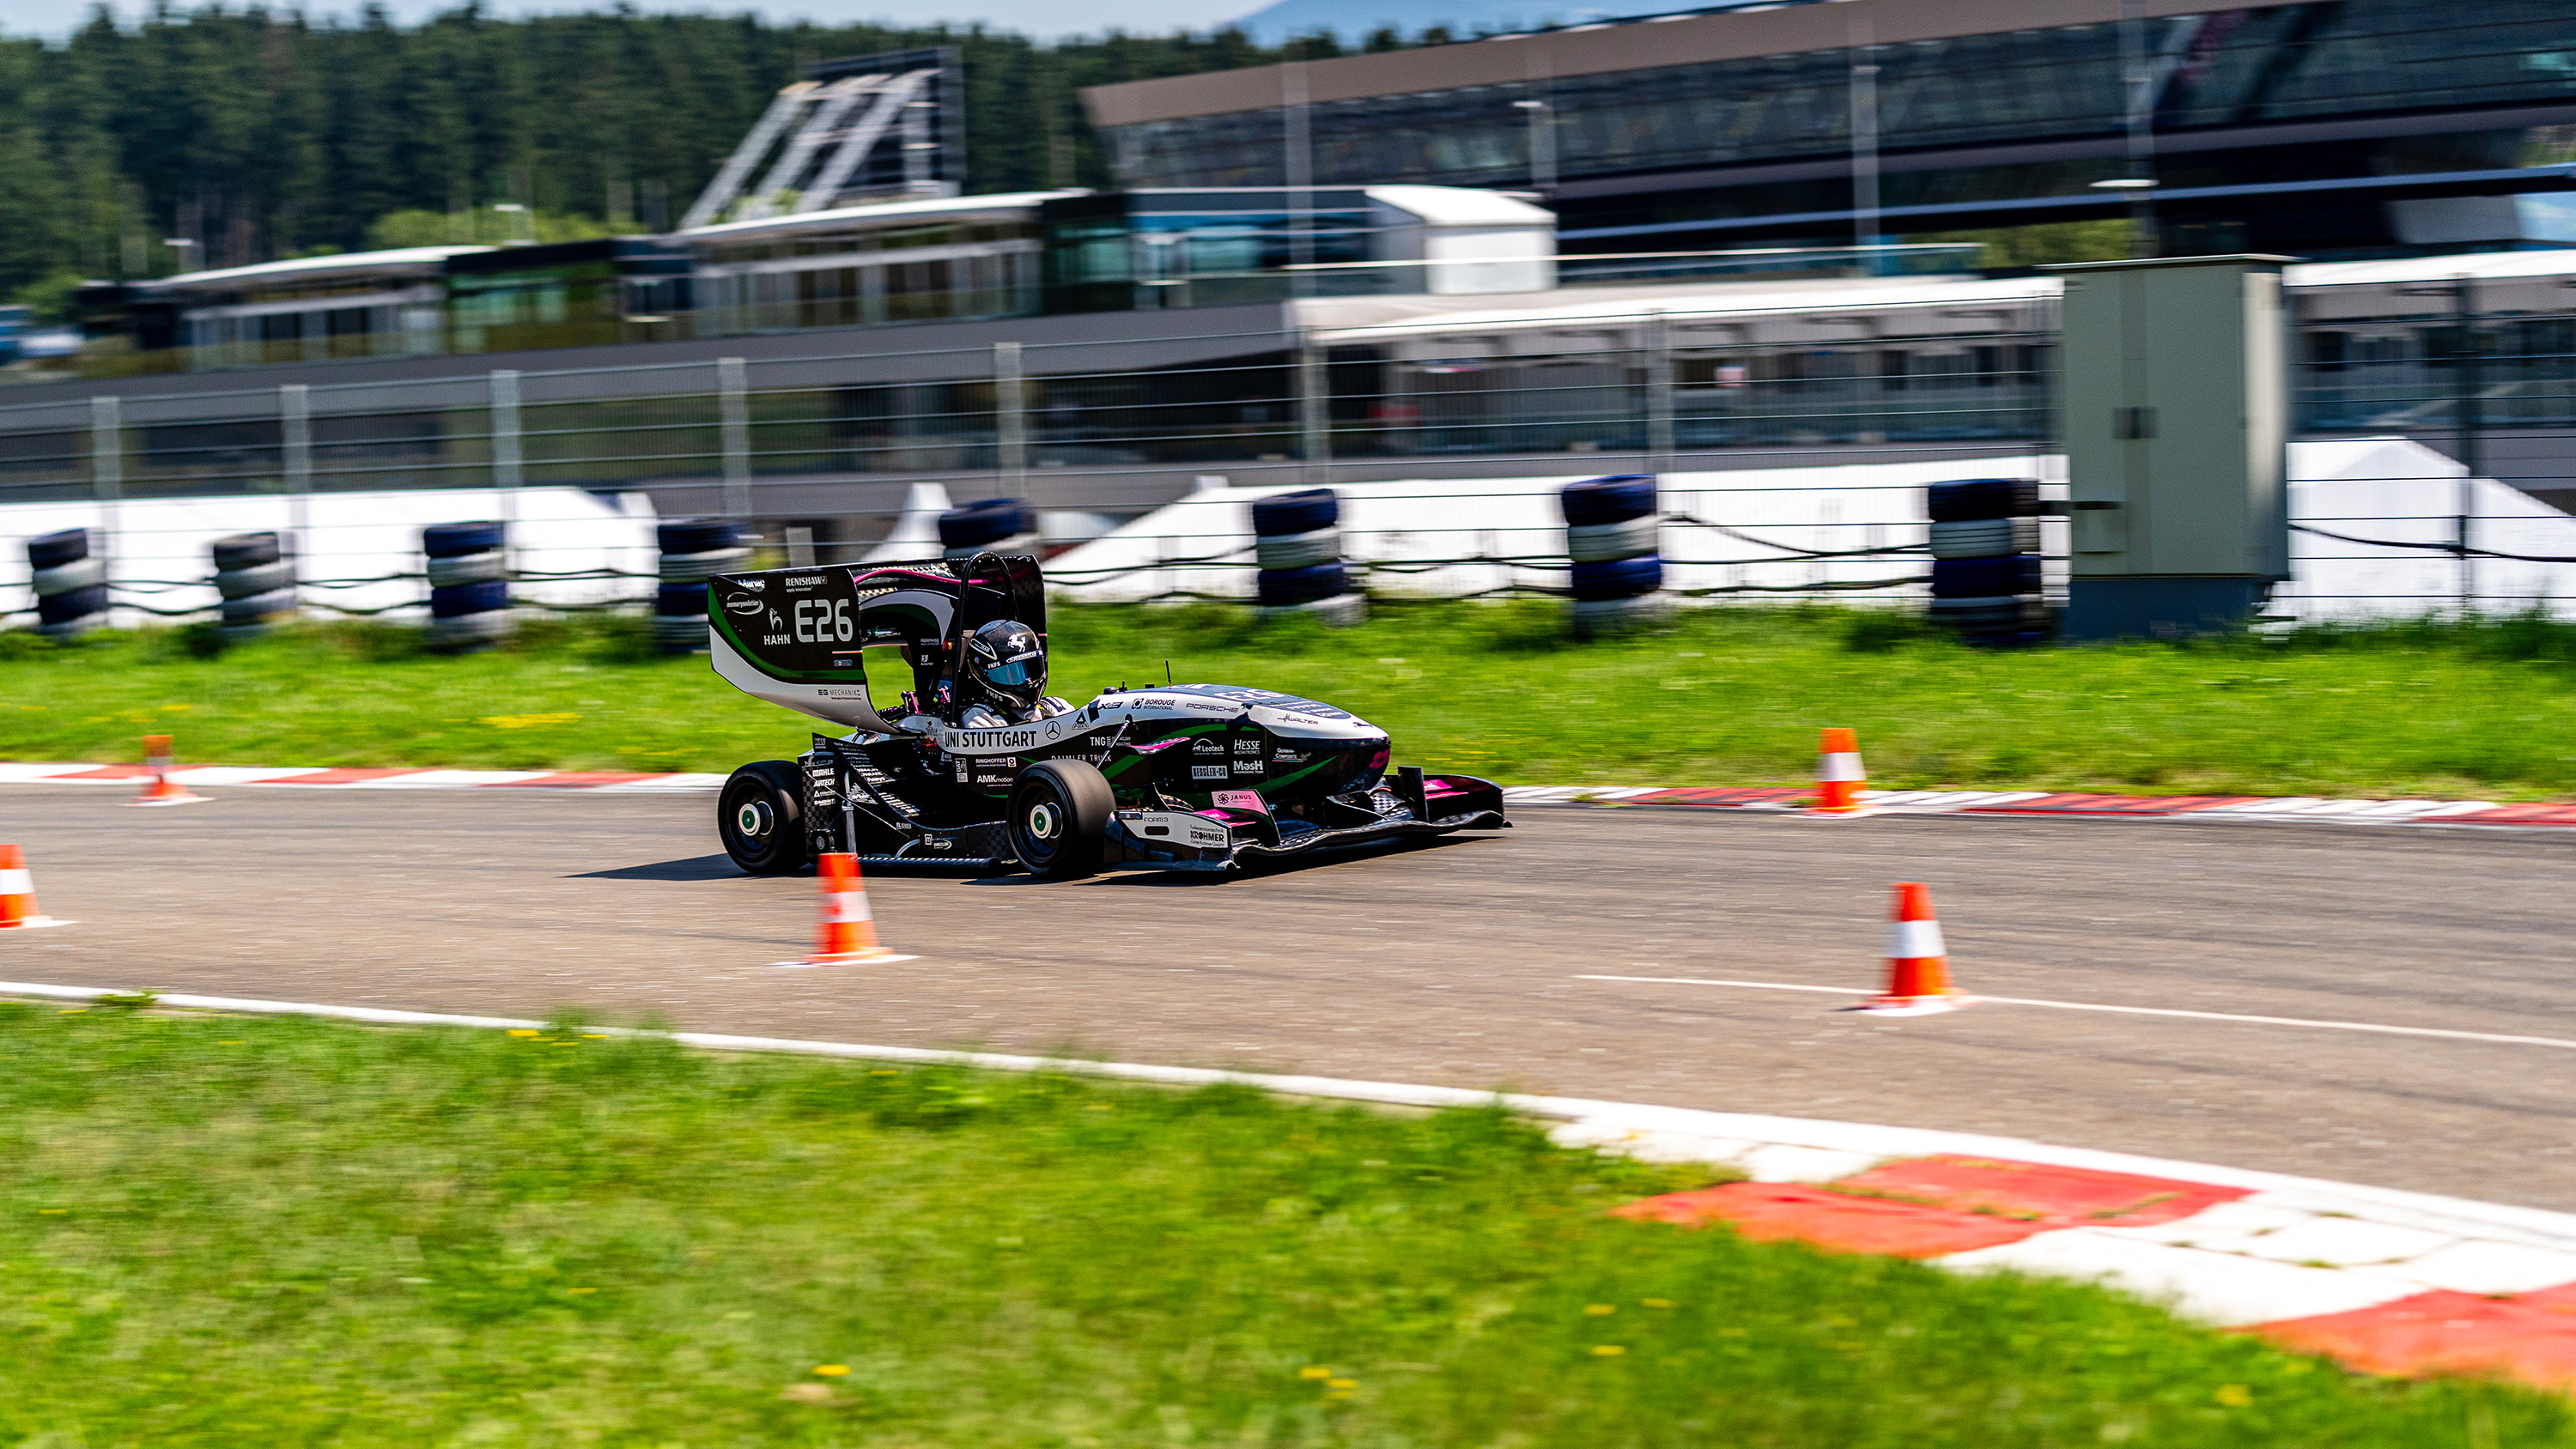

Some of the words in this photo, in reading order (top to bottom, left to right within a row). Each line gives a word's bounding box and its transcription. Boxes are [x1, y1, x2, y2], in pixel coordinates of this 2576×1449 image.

[786, 576, 822, 586] RENISHAW
[795, 599, 853, 643] E26
[764, 634, 791, 645] HAHN
[986, 689, 1003, 701] FKFS
[1186, 702, 1239, 713] PORSCHE
[1289, 717, 1319, 725] WALTER
[945, 731, 959, 748] UNI
[963, 731, 1036, 748] STUTTGART
[1090, 737, 1105, 746] TNG
[1234, 739, 1261, 749] HESSE
[812, 768, 834, 777] MAHLE
[1190, 830, 1224, 842] KROHMER
